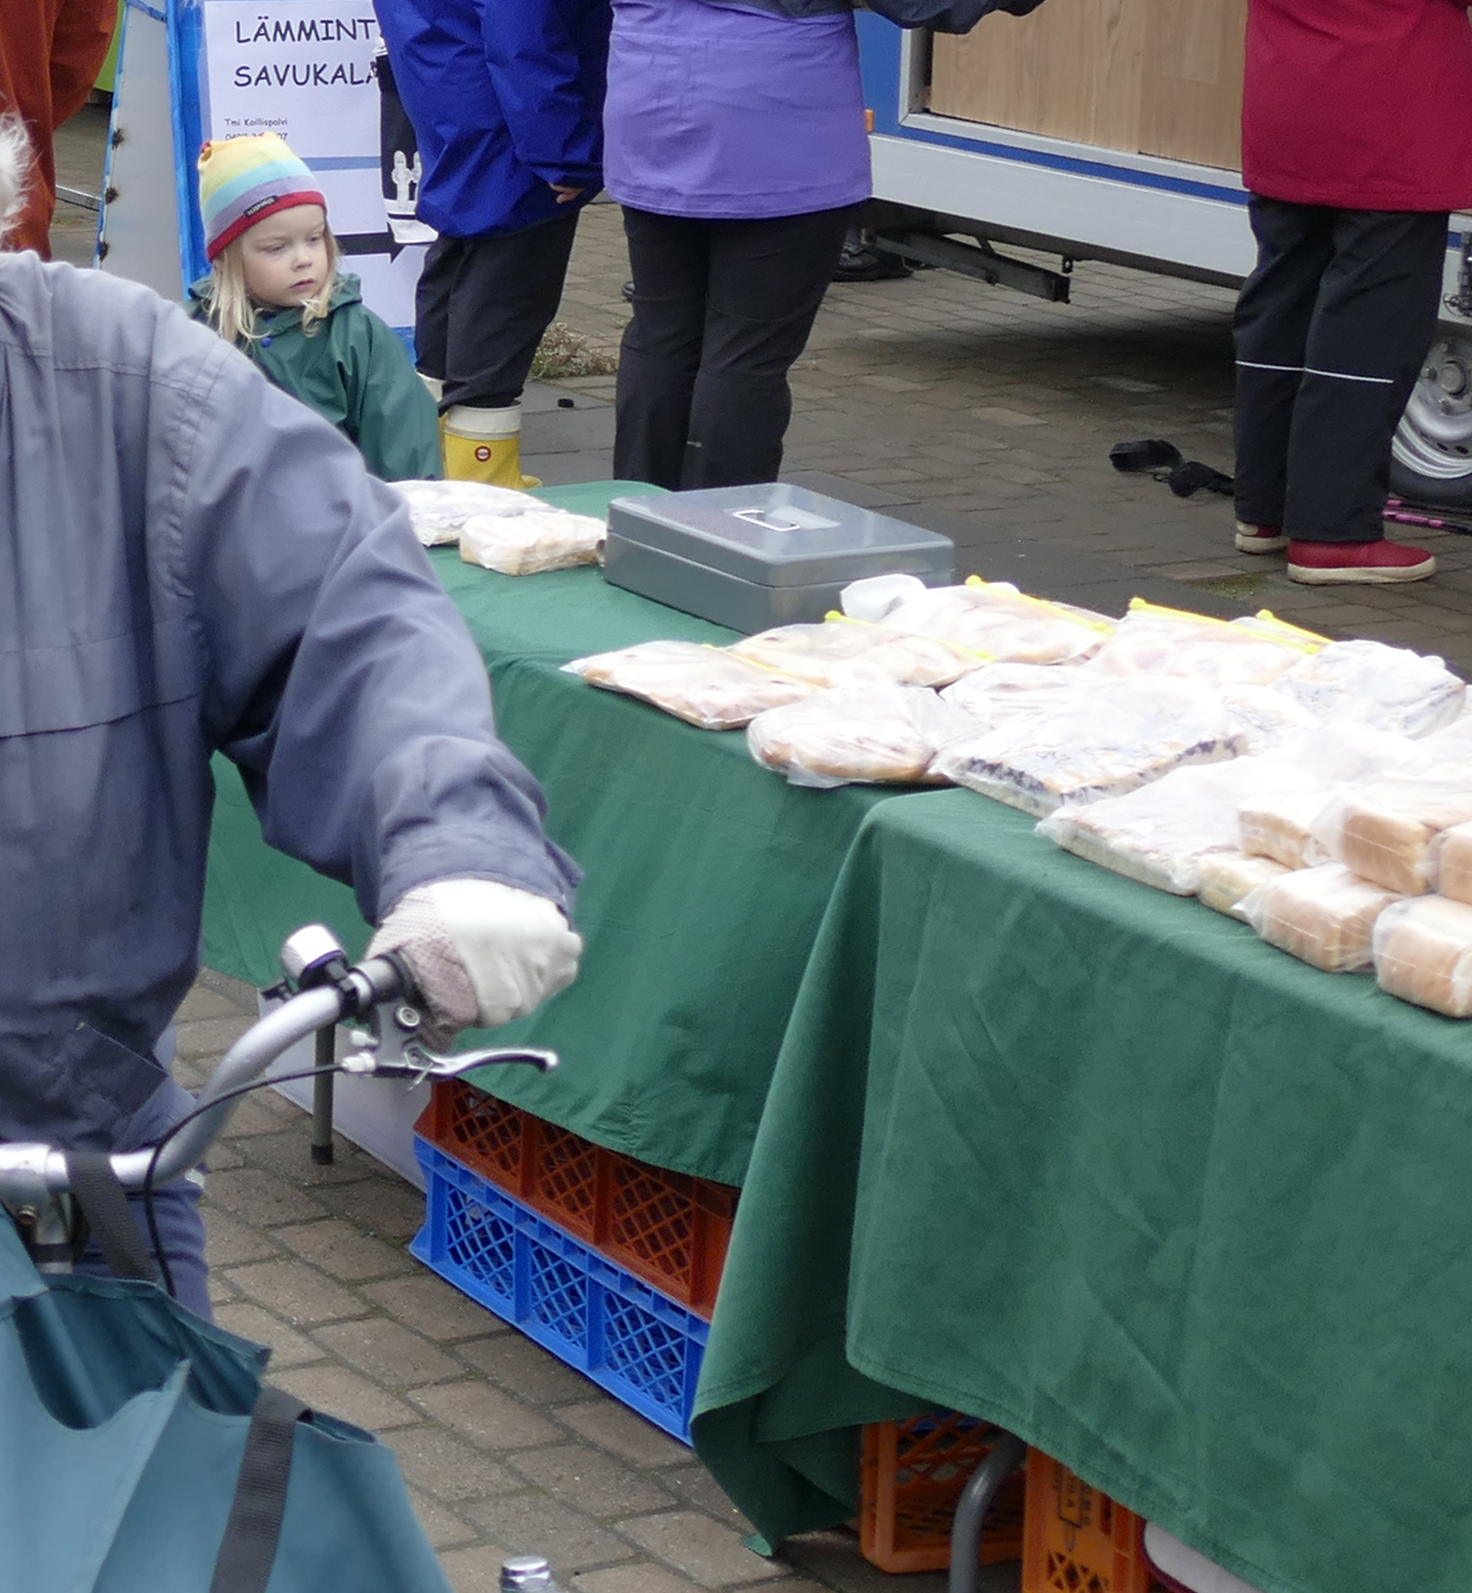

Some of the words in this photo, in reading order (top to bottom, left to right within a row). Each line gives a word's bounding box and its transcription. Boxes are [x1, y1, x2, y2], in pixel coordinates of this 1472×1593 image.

[235, 15, 376, 43] LÄMMINT
[233, 62, 378, 87] SAVUKAL
[224, 118, 241, 126] Tmi
